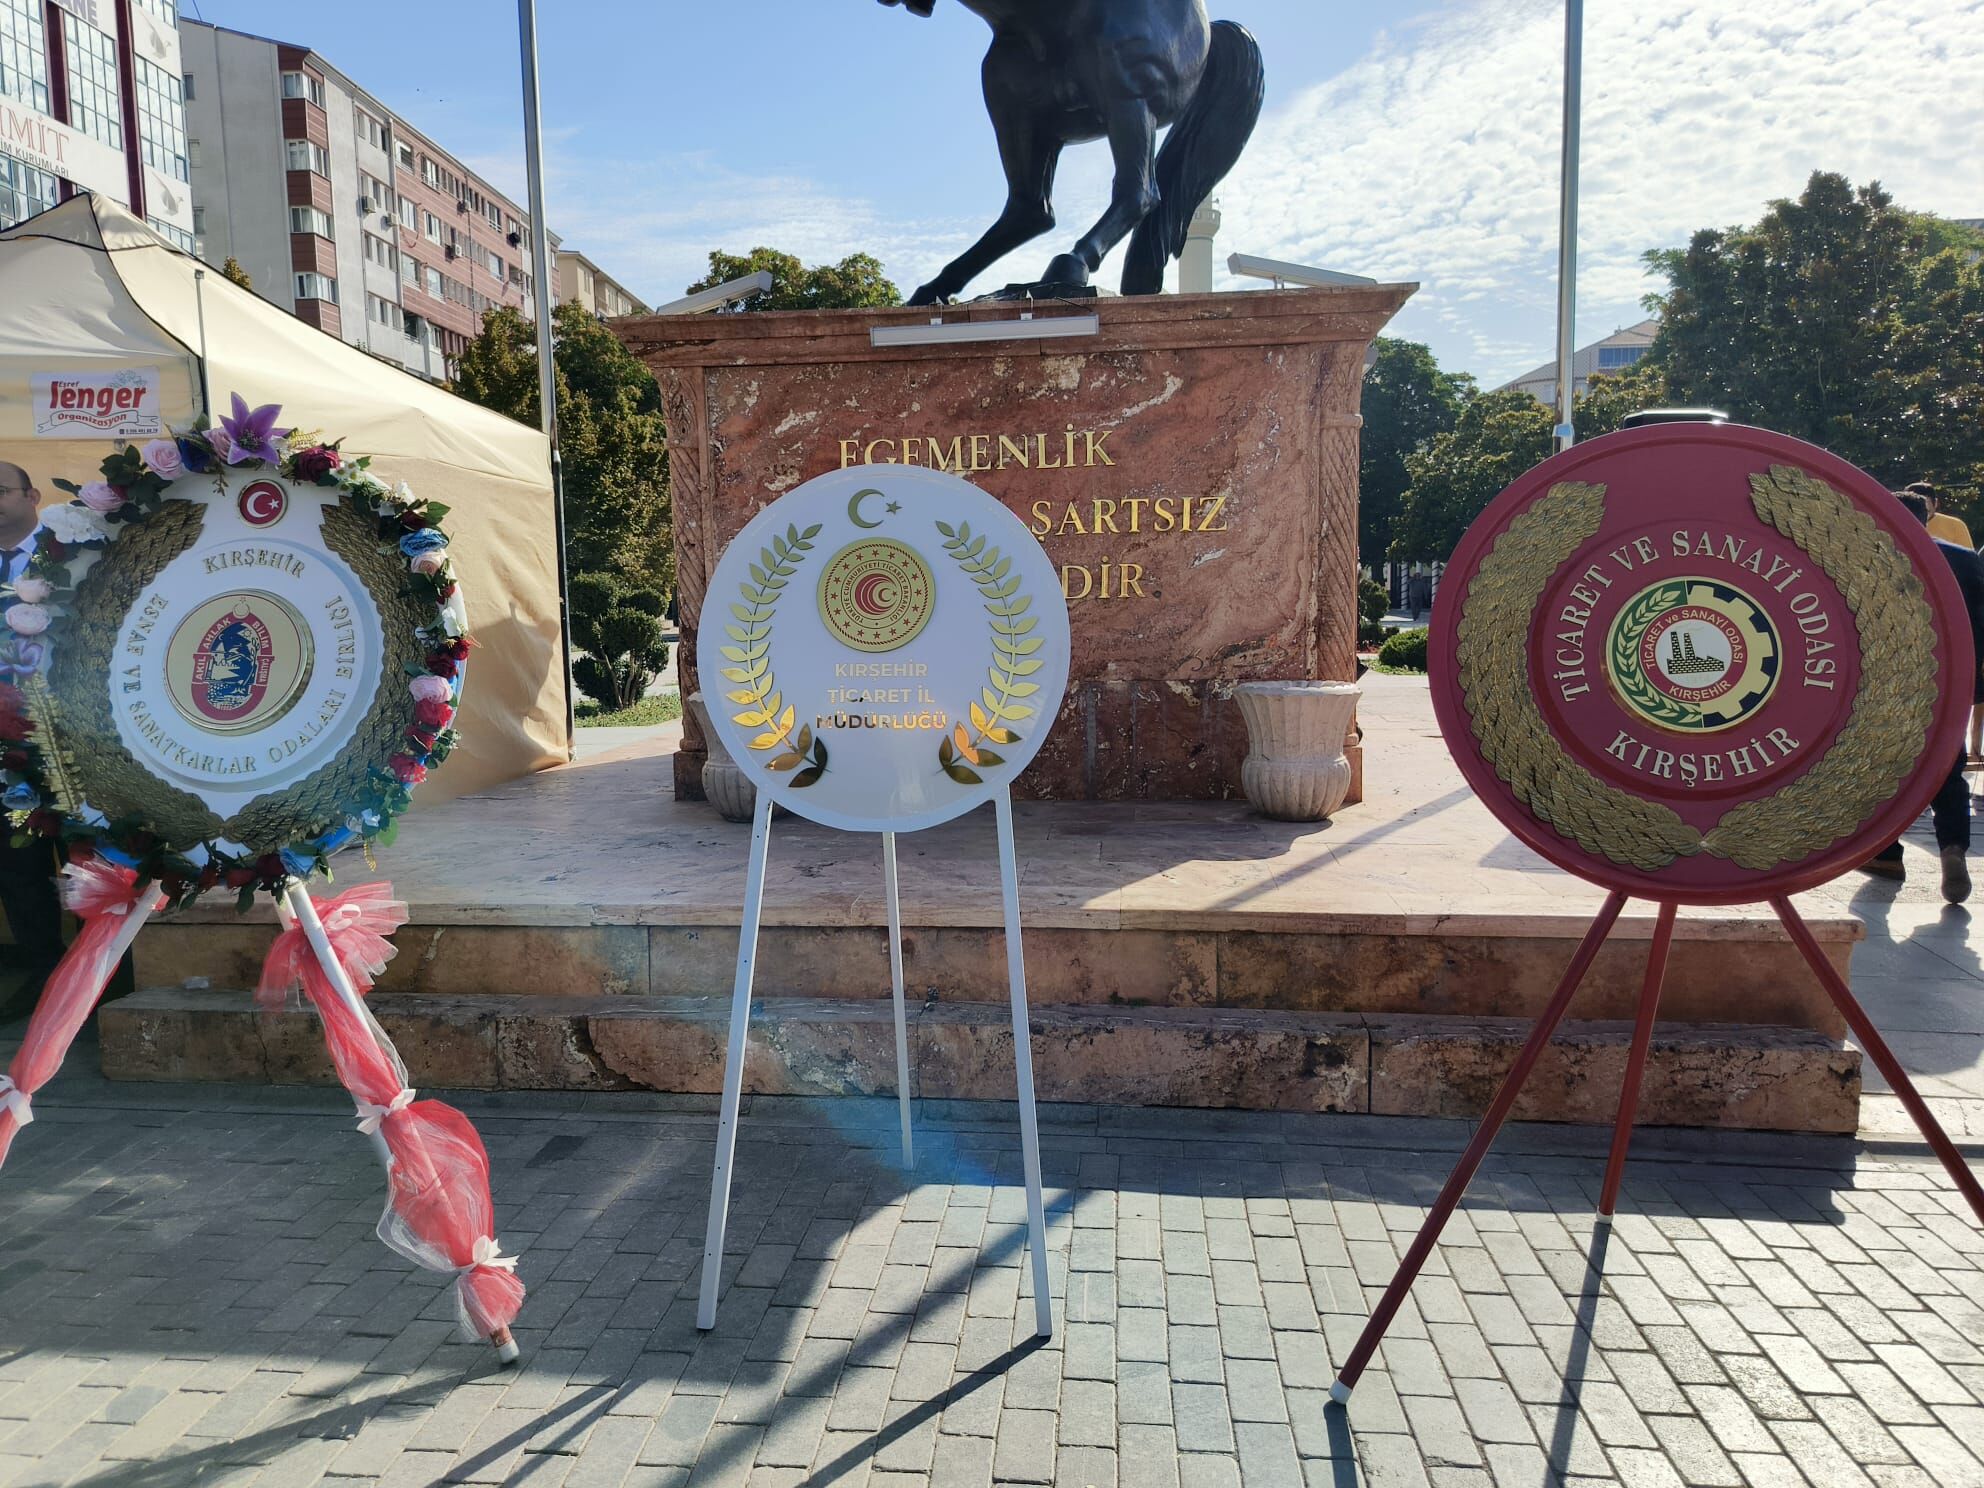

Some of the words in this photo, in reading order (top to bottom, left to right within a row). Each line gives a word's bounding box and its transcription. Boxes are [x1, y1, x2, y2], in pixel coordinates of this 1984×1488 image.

[57, 412, 127, 428] Organizasyon
[839, 423, 1116, 472] EGEMENLİK
[1030, 496, 1229, 543] ŞARTSIZ
[202, 548, 306, 579] KIRŞEHİR
[126, 593, 169, 657] ESNAF
[1553, 563, 1613, 702] TİCARET
[1609, 535, 1660, 572] VE
[1672, 530, 1803, 593] SANAYİ
[1789, 592, 1837, 691] ODASI
[203, 617, 231, 650] AHLAK
[1643, 621, 1665, 670] TİCARET
[1664, 614, 1679, 625] ve
[1681, 609, 1729, 628] SANAYİ
[1725, 627, 1743, 664] ODASI
[122, 664, 141, 694] VE
[195, 655, 207, 680] AKIL
[835, 659, 928, 681] KIRŞEHİR
[827, 685, 912, 703] TİCARET
[918, 684, 935, 703] İL
[1669, 680, 1732, 701] KIRŞEHİR
[129, 699, 256, 774] SANATKARLAR
[269, 689, 346, 763] ODALARI
[816, 711, 947, 729] MÜDÜRLÜĞÜ
[1604, 726, 1801, 787] KIRŞEHİR
